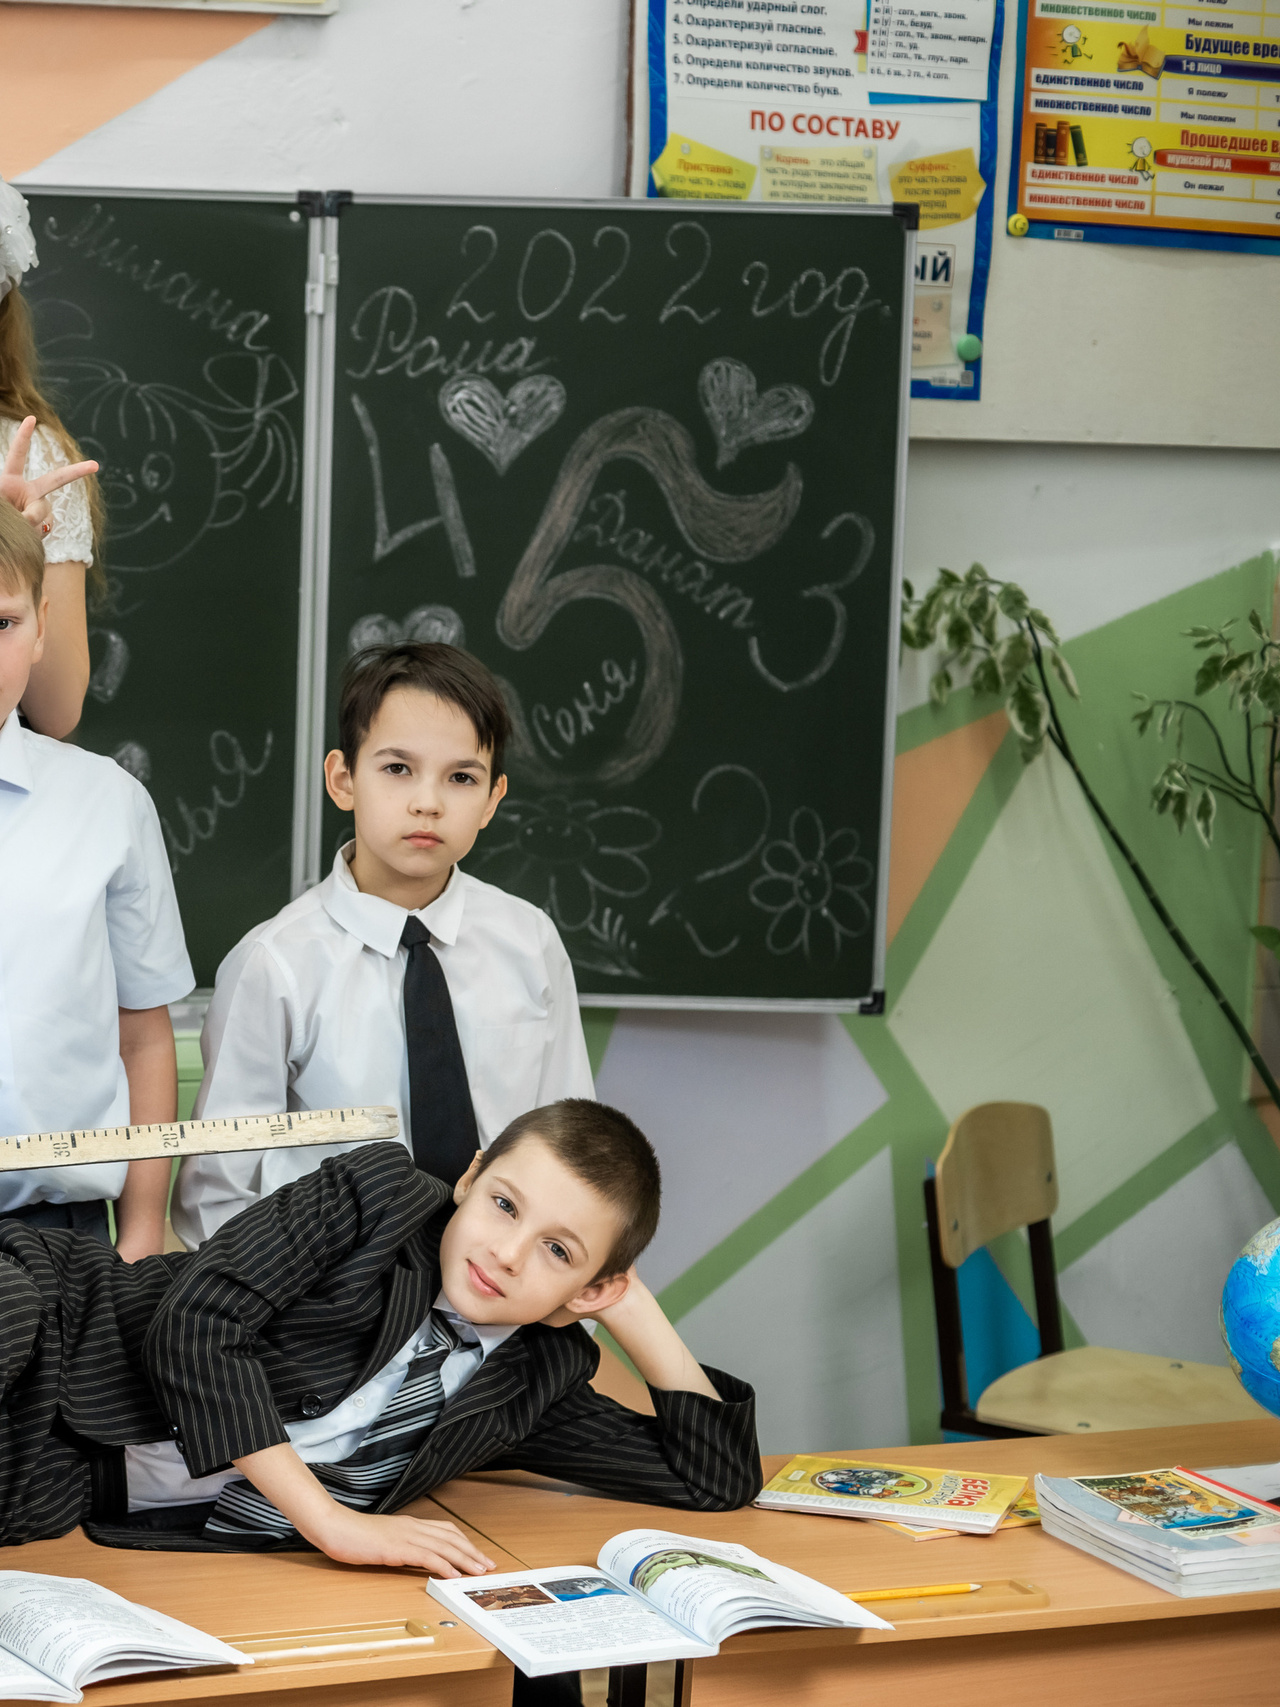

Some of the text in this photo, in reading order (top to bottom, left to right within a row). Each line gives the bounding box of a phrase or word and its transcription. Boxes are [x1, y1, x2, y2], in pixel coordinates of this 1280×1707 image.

[747, 0, 798, 13] ударный
[800, 4, 828, 16] слог.
[1040, 3, 1234, 29] множественное число Мы лежим
[673, 14, 826, 35] 4. Охарактеризуй гласные.
[673, 34, 838, 56] 5. Охарактеризуй согласные.
[1185, 33, 1280, 59] Будущее вре
[673, 54, 855, 77] 6. Определи количество звуков.
[1182, 59, 1222, 74] 1-е лицо
[673, 73, 842, 97] 7. Определи количество букв.
[1035, 73, 1111, 88] единственное
[1113, 78, 1144, 91] число
[1196, 89, 1228, 98] полежу
[1035, 97, 1120, 114] множественное
[1121, 103, 1151, 116] число
[1180, 111, 1195, 119] Мы
[750, 110, 901, 140] ПО СОСТАВУ
[1181, 129, 1268, 153] Прошедшее
[1167, 153, 1232, 171] мужской род
[1031, 168, 1106, 184] единственное
[1108, 173, 1139, 186] число
[1184, 181, 1196, 189] Он
[1029, 193, 1145, 210] множественное число
[447, 221, 721, 324] 2022
[915, 251, 951, 282] ЫЙ
[532, 658, 637, 760] Соня
[54, 1141, 71, 1158] 30
[163, 1131, 180, 1149] 20
[270, 1123, 286, 1138] 10
